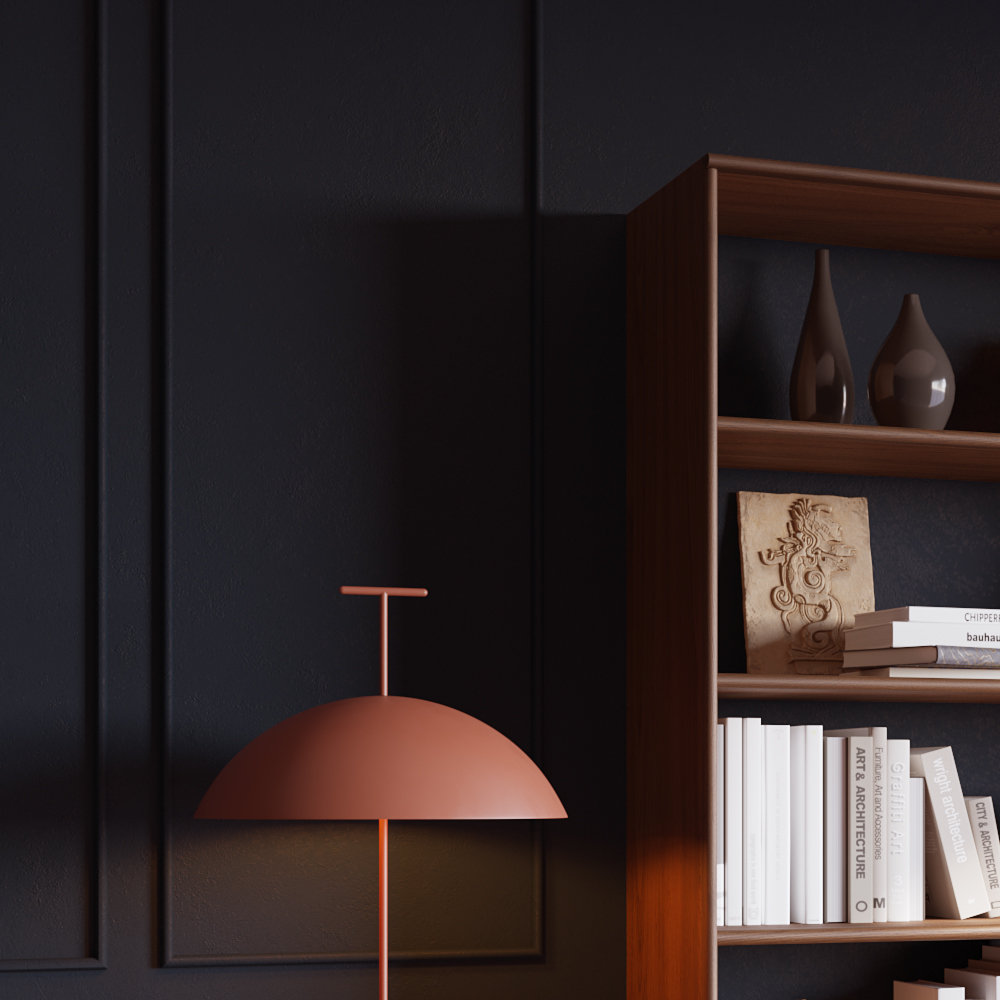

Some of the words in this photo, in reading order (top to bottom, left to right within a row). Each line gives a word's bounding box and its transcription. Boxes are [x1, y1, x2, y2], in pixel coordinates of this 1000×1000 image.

[856, 747, 866, 770] ART
[874, 747, 884, 782] Furniture,
[856, 772, 866, 781] &
[891, 762, 904, 823] Graffiti
[932, 757, 950, 794] wright
[942, 795, 968, 864] architecture
[976, 802, 988, 820] CITY
[856, 786, 866, 879] ARCHITECTURE
[891, 832, 903, 855] Art
[980, 830, 1000, 889] ARCHITECTURE
